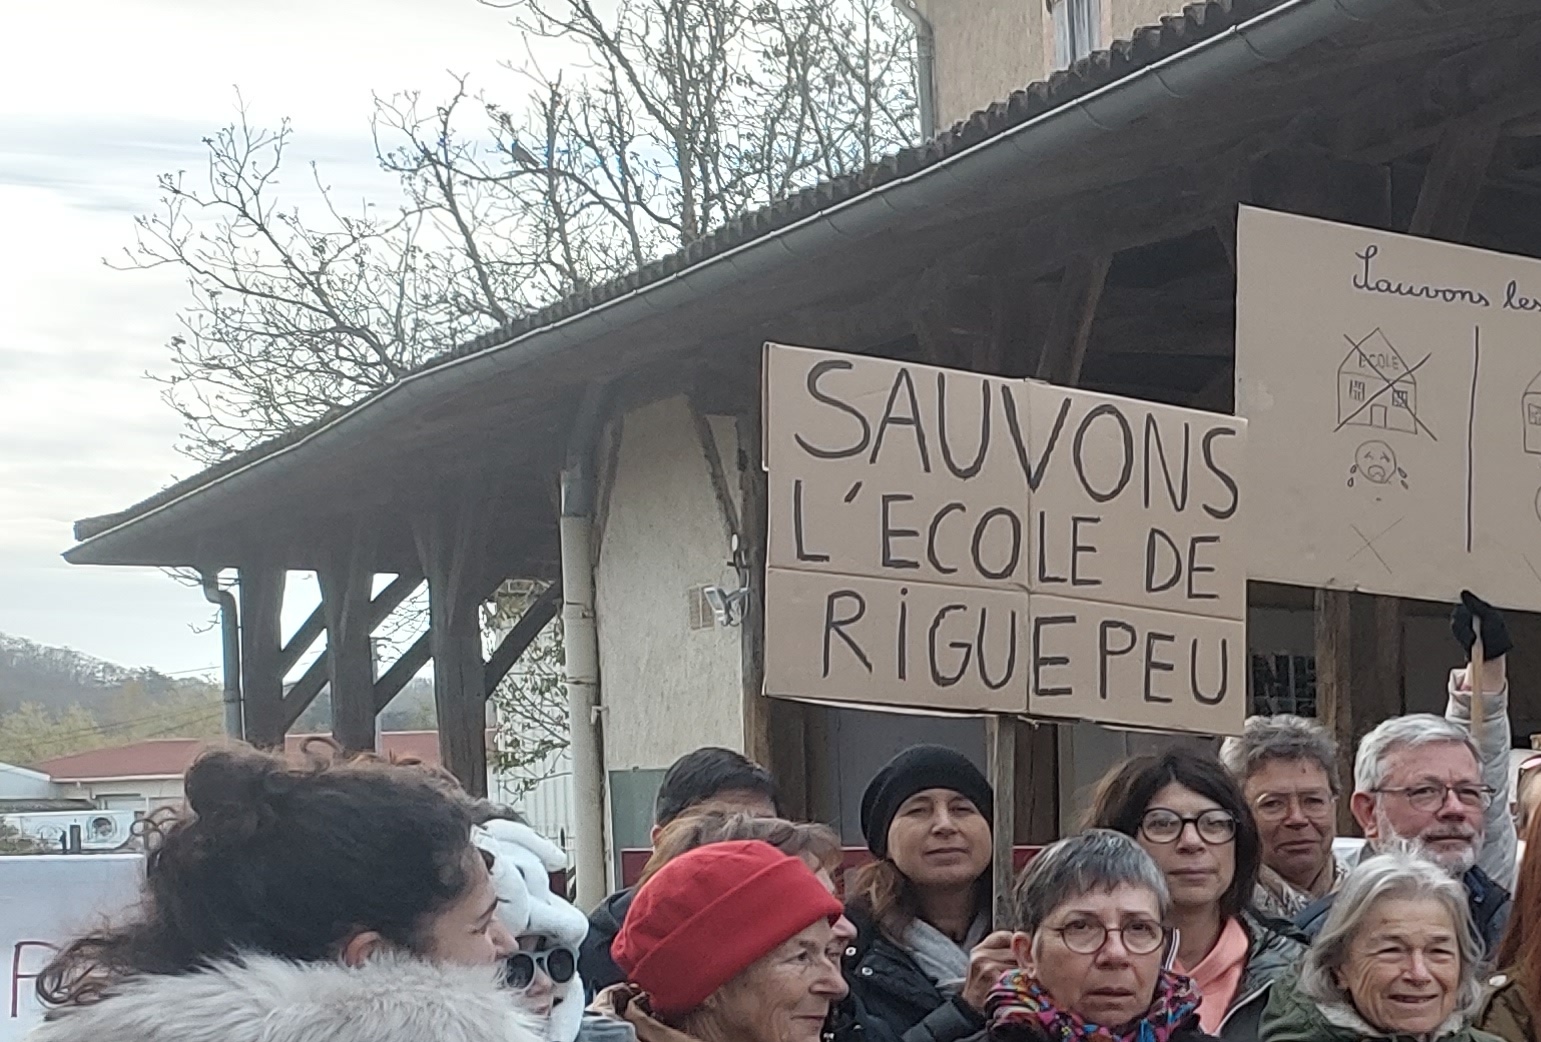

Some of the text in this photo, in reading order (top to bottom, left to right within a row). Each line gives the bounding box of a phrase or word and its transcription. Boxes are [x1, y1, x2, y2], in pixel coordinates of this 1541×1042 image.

[1352, 244, 1491, 308] Sauvons
[1358, 352, 1400, 371] ECOLE
[795, 359, 1239, 519] SAUVONS
[1145, 527, 1221, 600] DE
